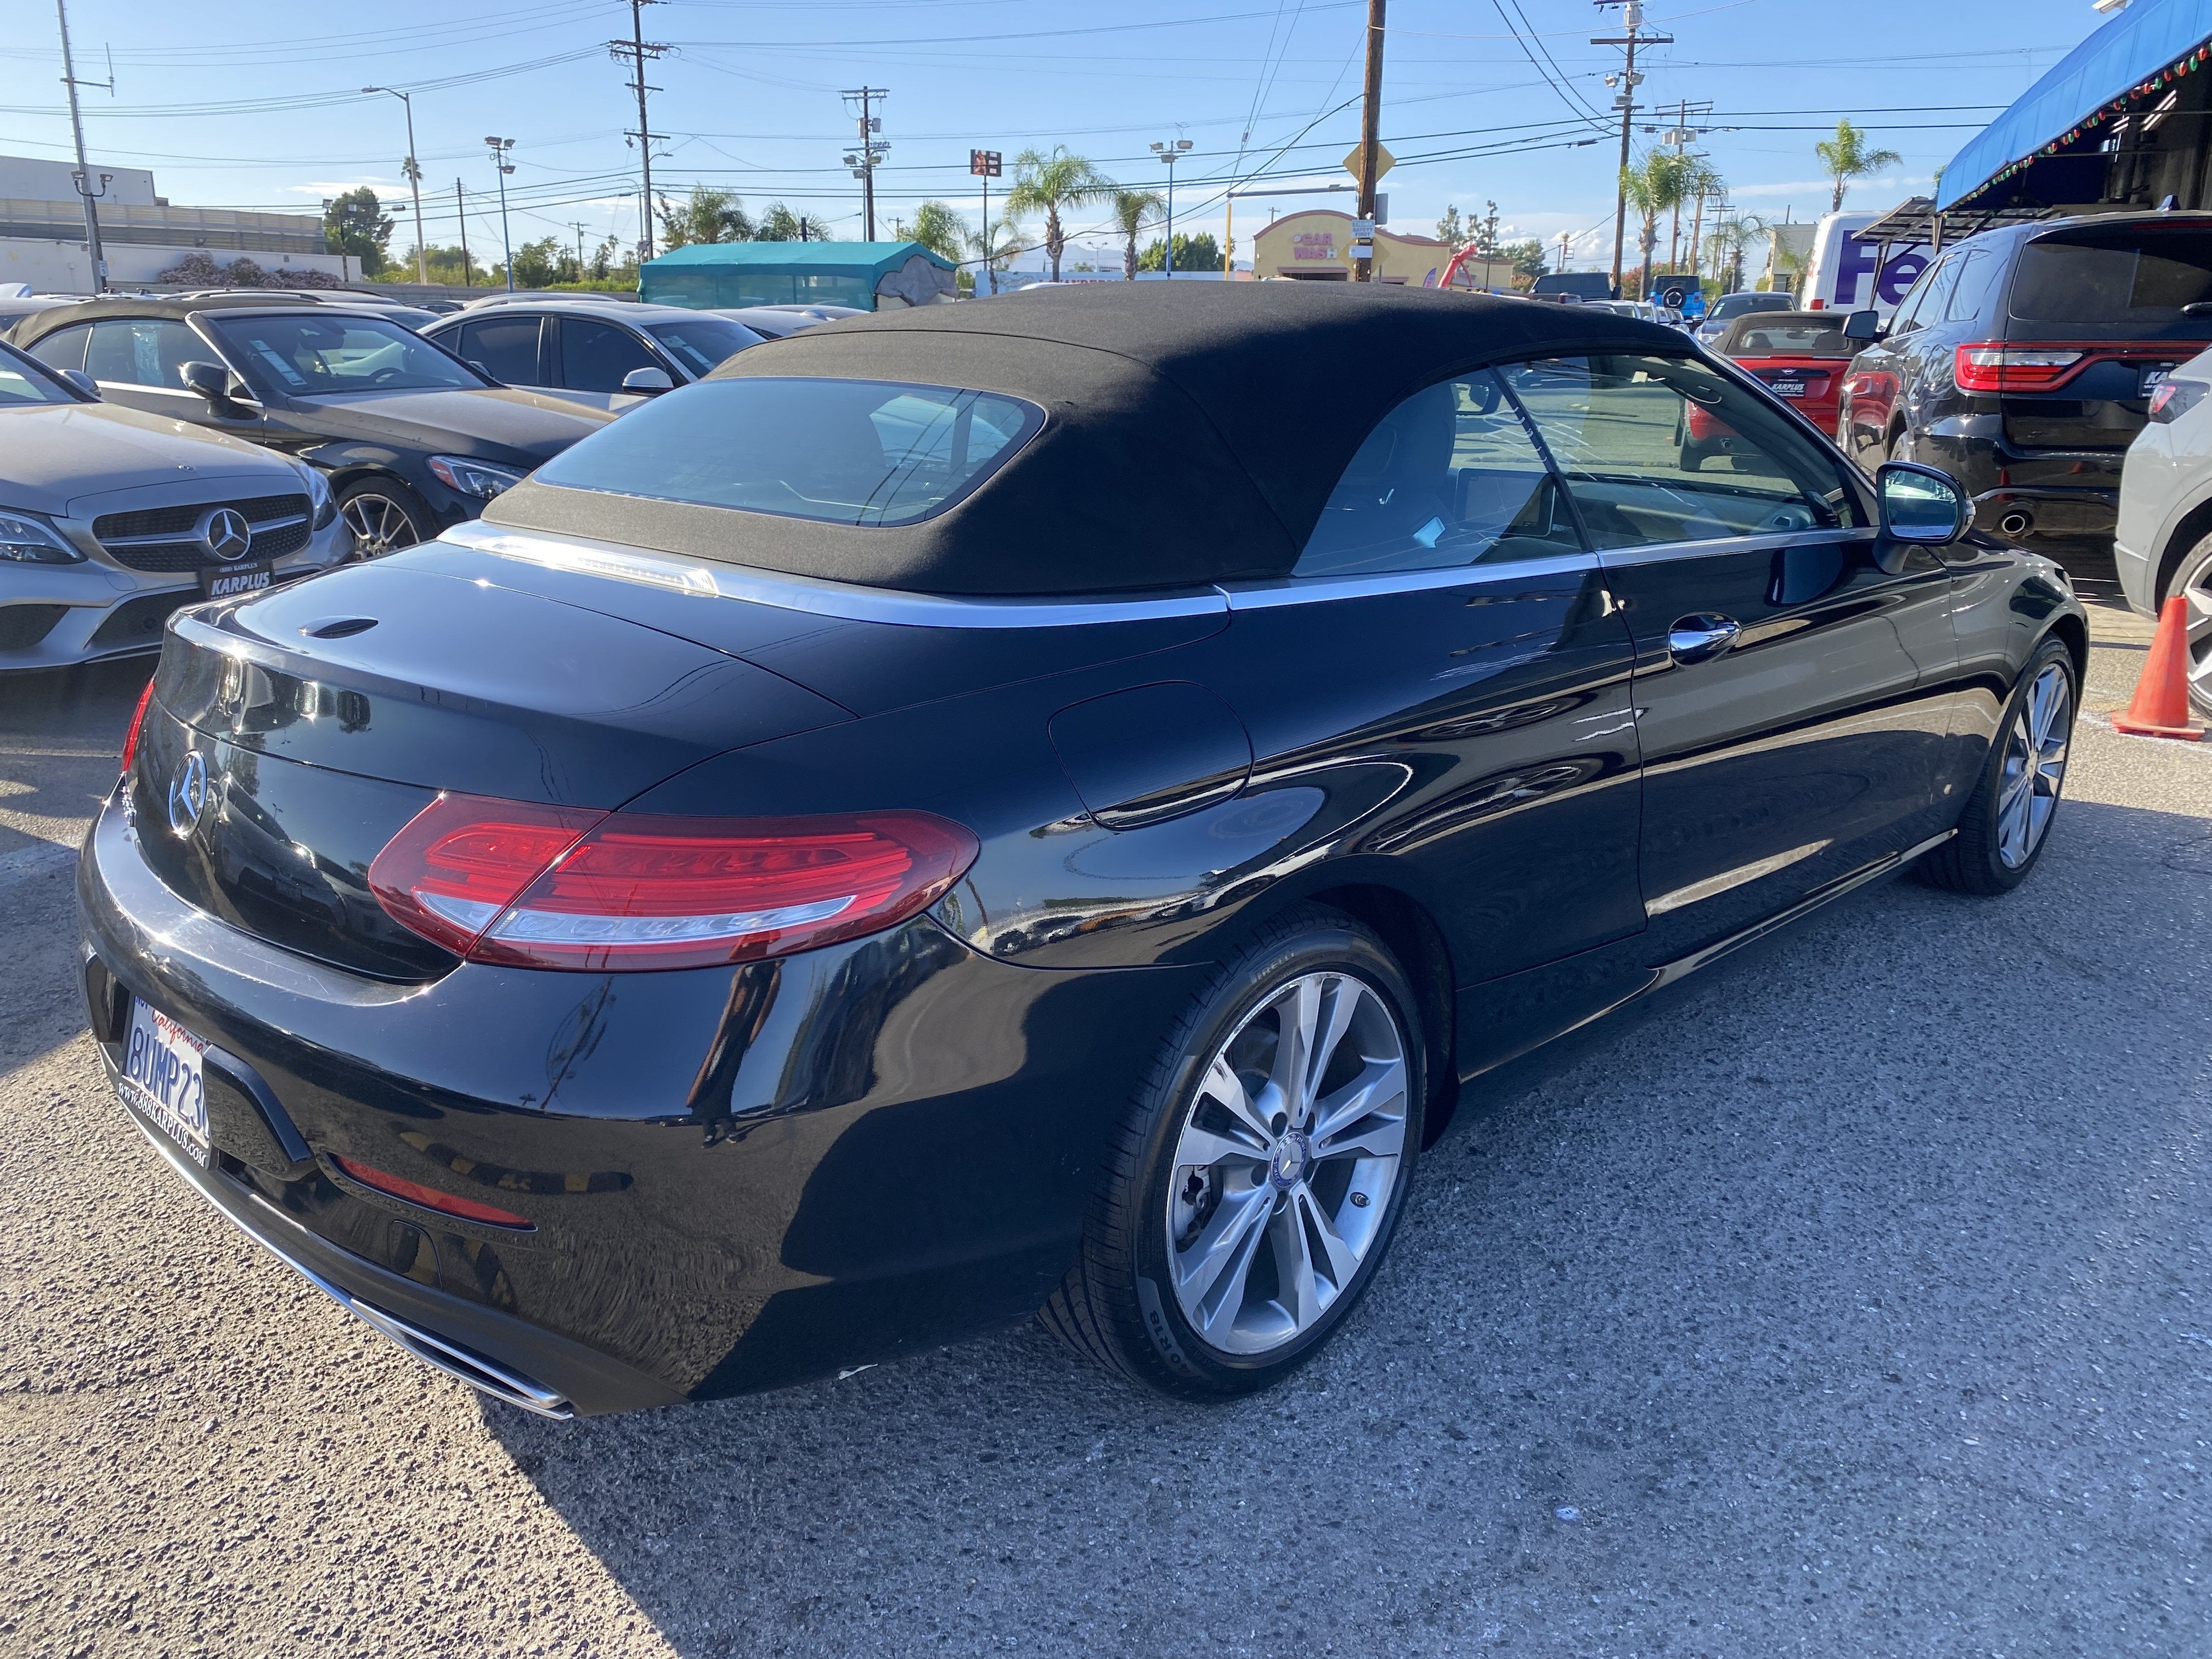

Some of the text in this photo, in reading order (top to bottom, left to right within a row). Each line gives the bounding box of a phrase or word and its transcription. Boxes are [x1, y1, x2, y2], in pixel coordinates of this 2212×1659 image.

[1302, 234, 1332, 245] CAR
[1294, 247, 1338, 259] WASH
[233, 562, 258, 571] KARPLUS
[211, 571, 270, 595] KARPLUS
[130, 1027, 210, 1141] 8UMP23
